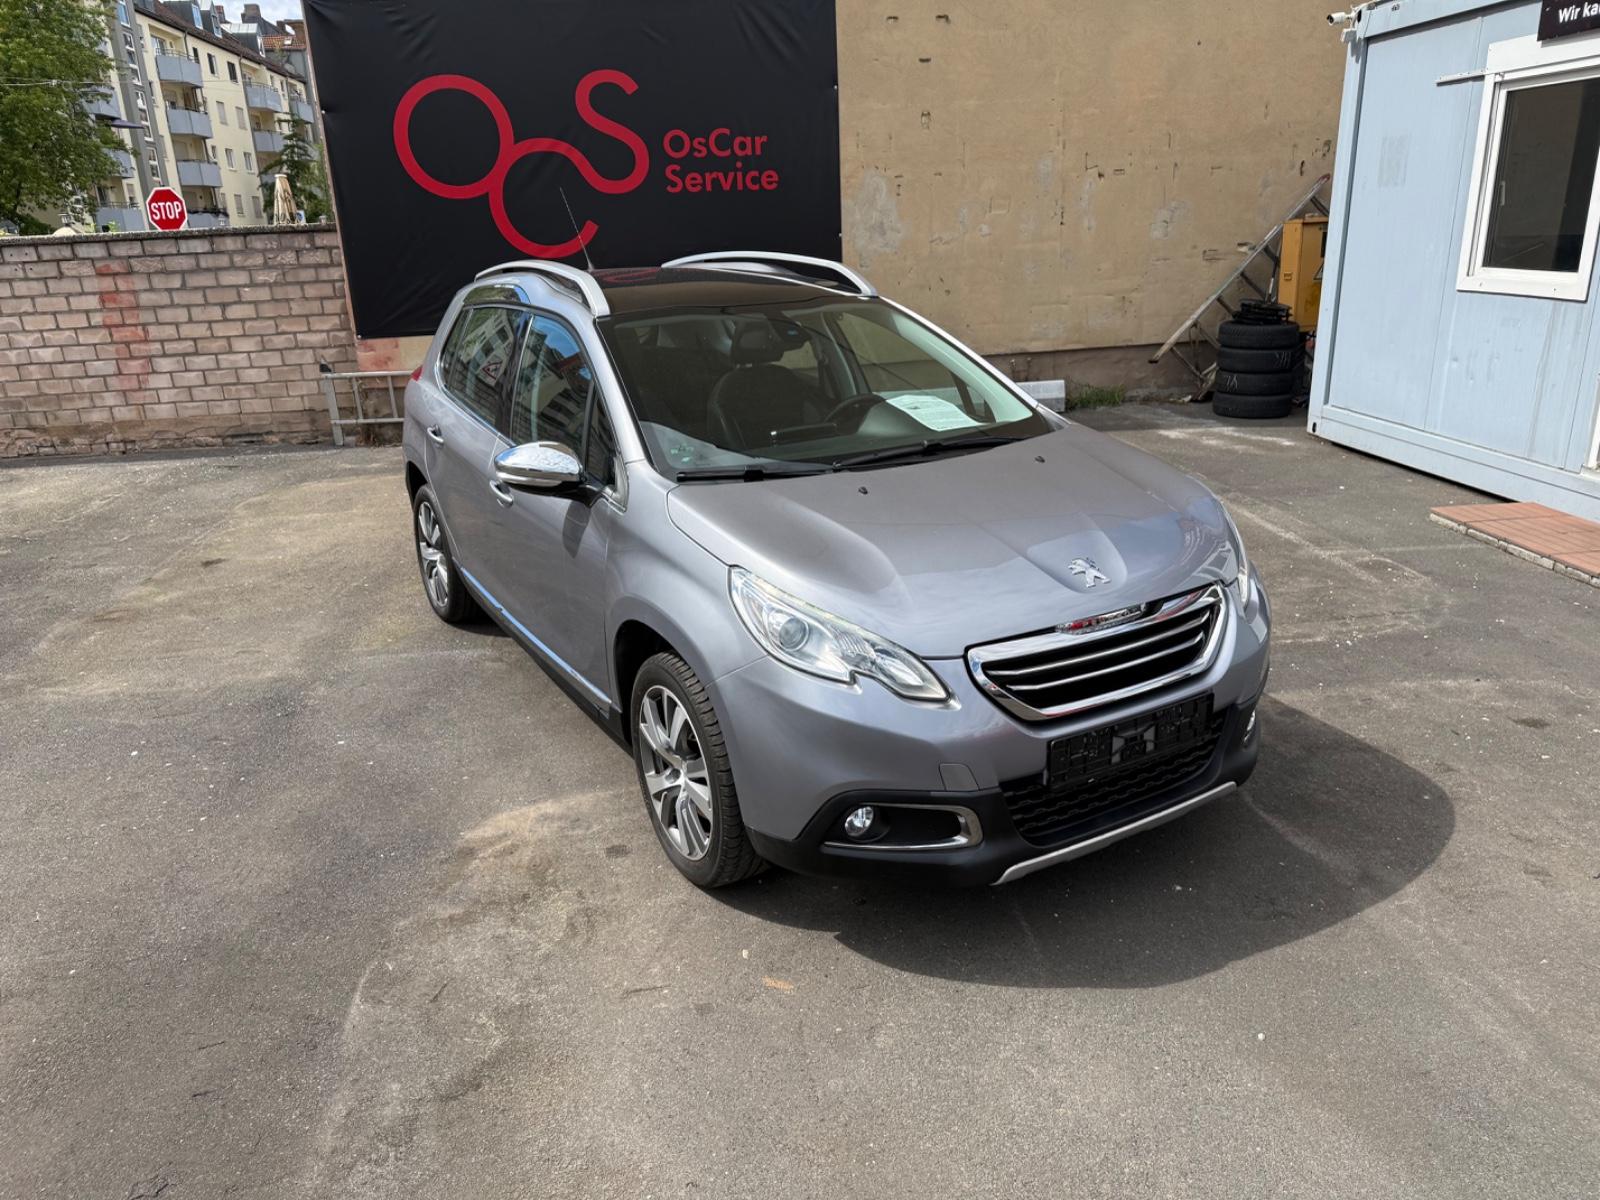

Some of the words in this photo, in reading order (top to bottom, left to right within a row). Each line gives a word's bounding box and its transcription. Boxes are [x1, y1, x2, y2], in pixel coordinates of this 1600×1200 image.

[1559, 5, 1581, 23] Wir
[1583, 2, 1600, 18] ka
[663, 128, 768, 159] OsCar
[665, 161, 779, 193] Service
[150, 201, 182, 220] STOP
